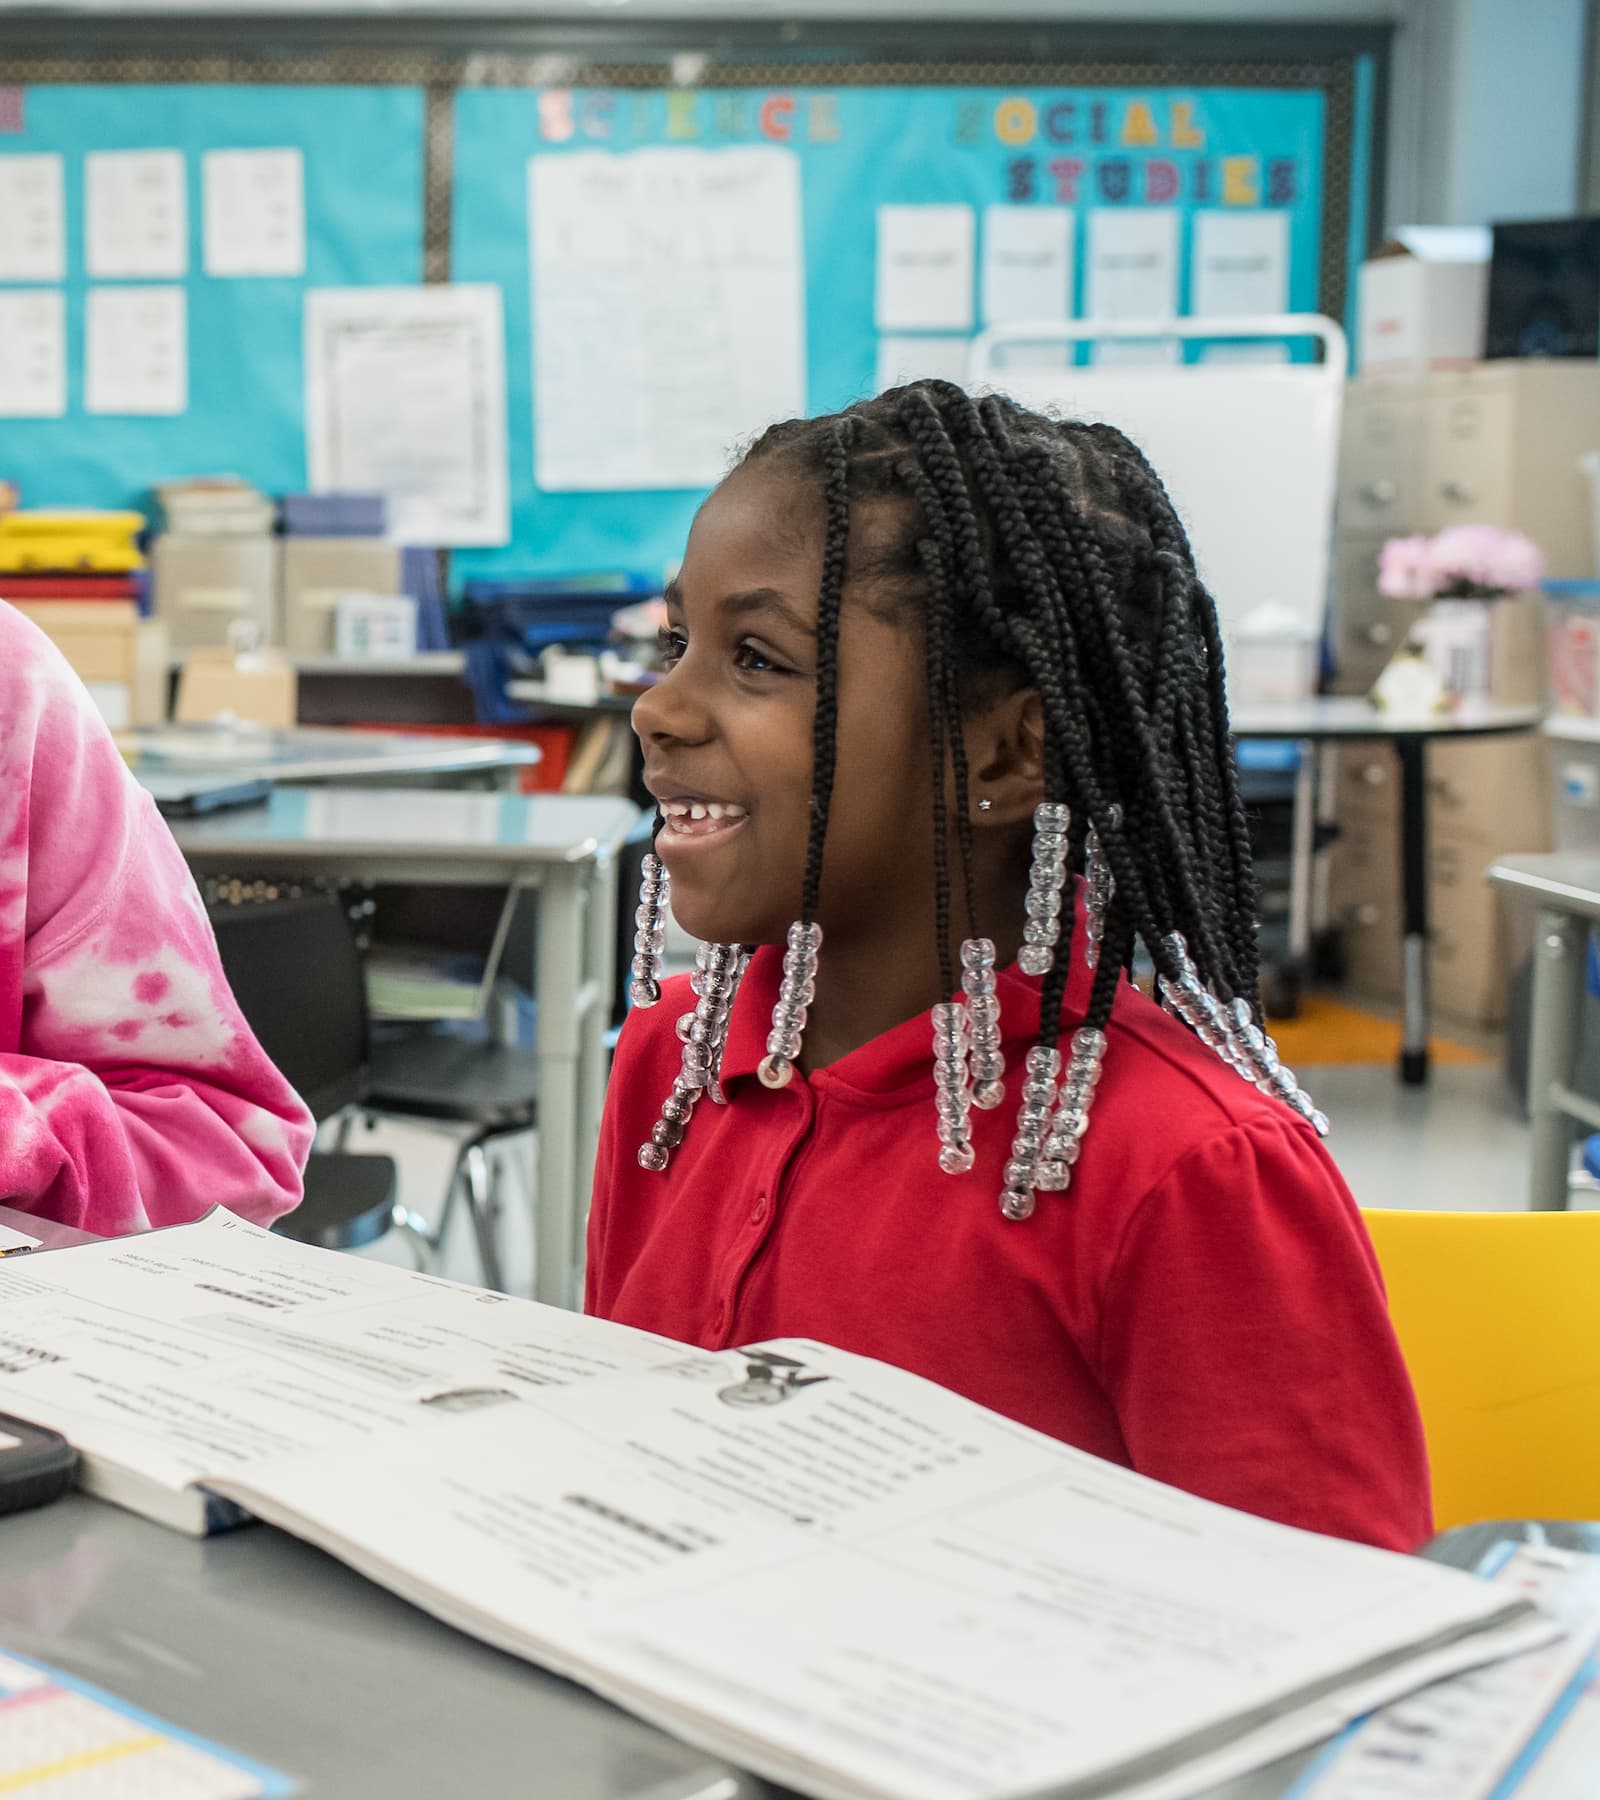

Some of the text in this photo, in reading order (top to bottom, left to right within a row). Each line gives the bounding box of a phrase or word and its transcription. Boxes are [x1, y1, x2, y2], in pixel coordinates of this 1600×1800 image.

[540, 90, 841, 142] SCIENCE
[955, 97, 1204, 148] SOCIAL
[1008, 157, 1296, 206] STUDIES
